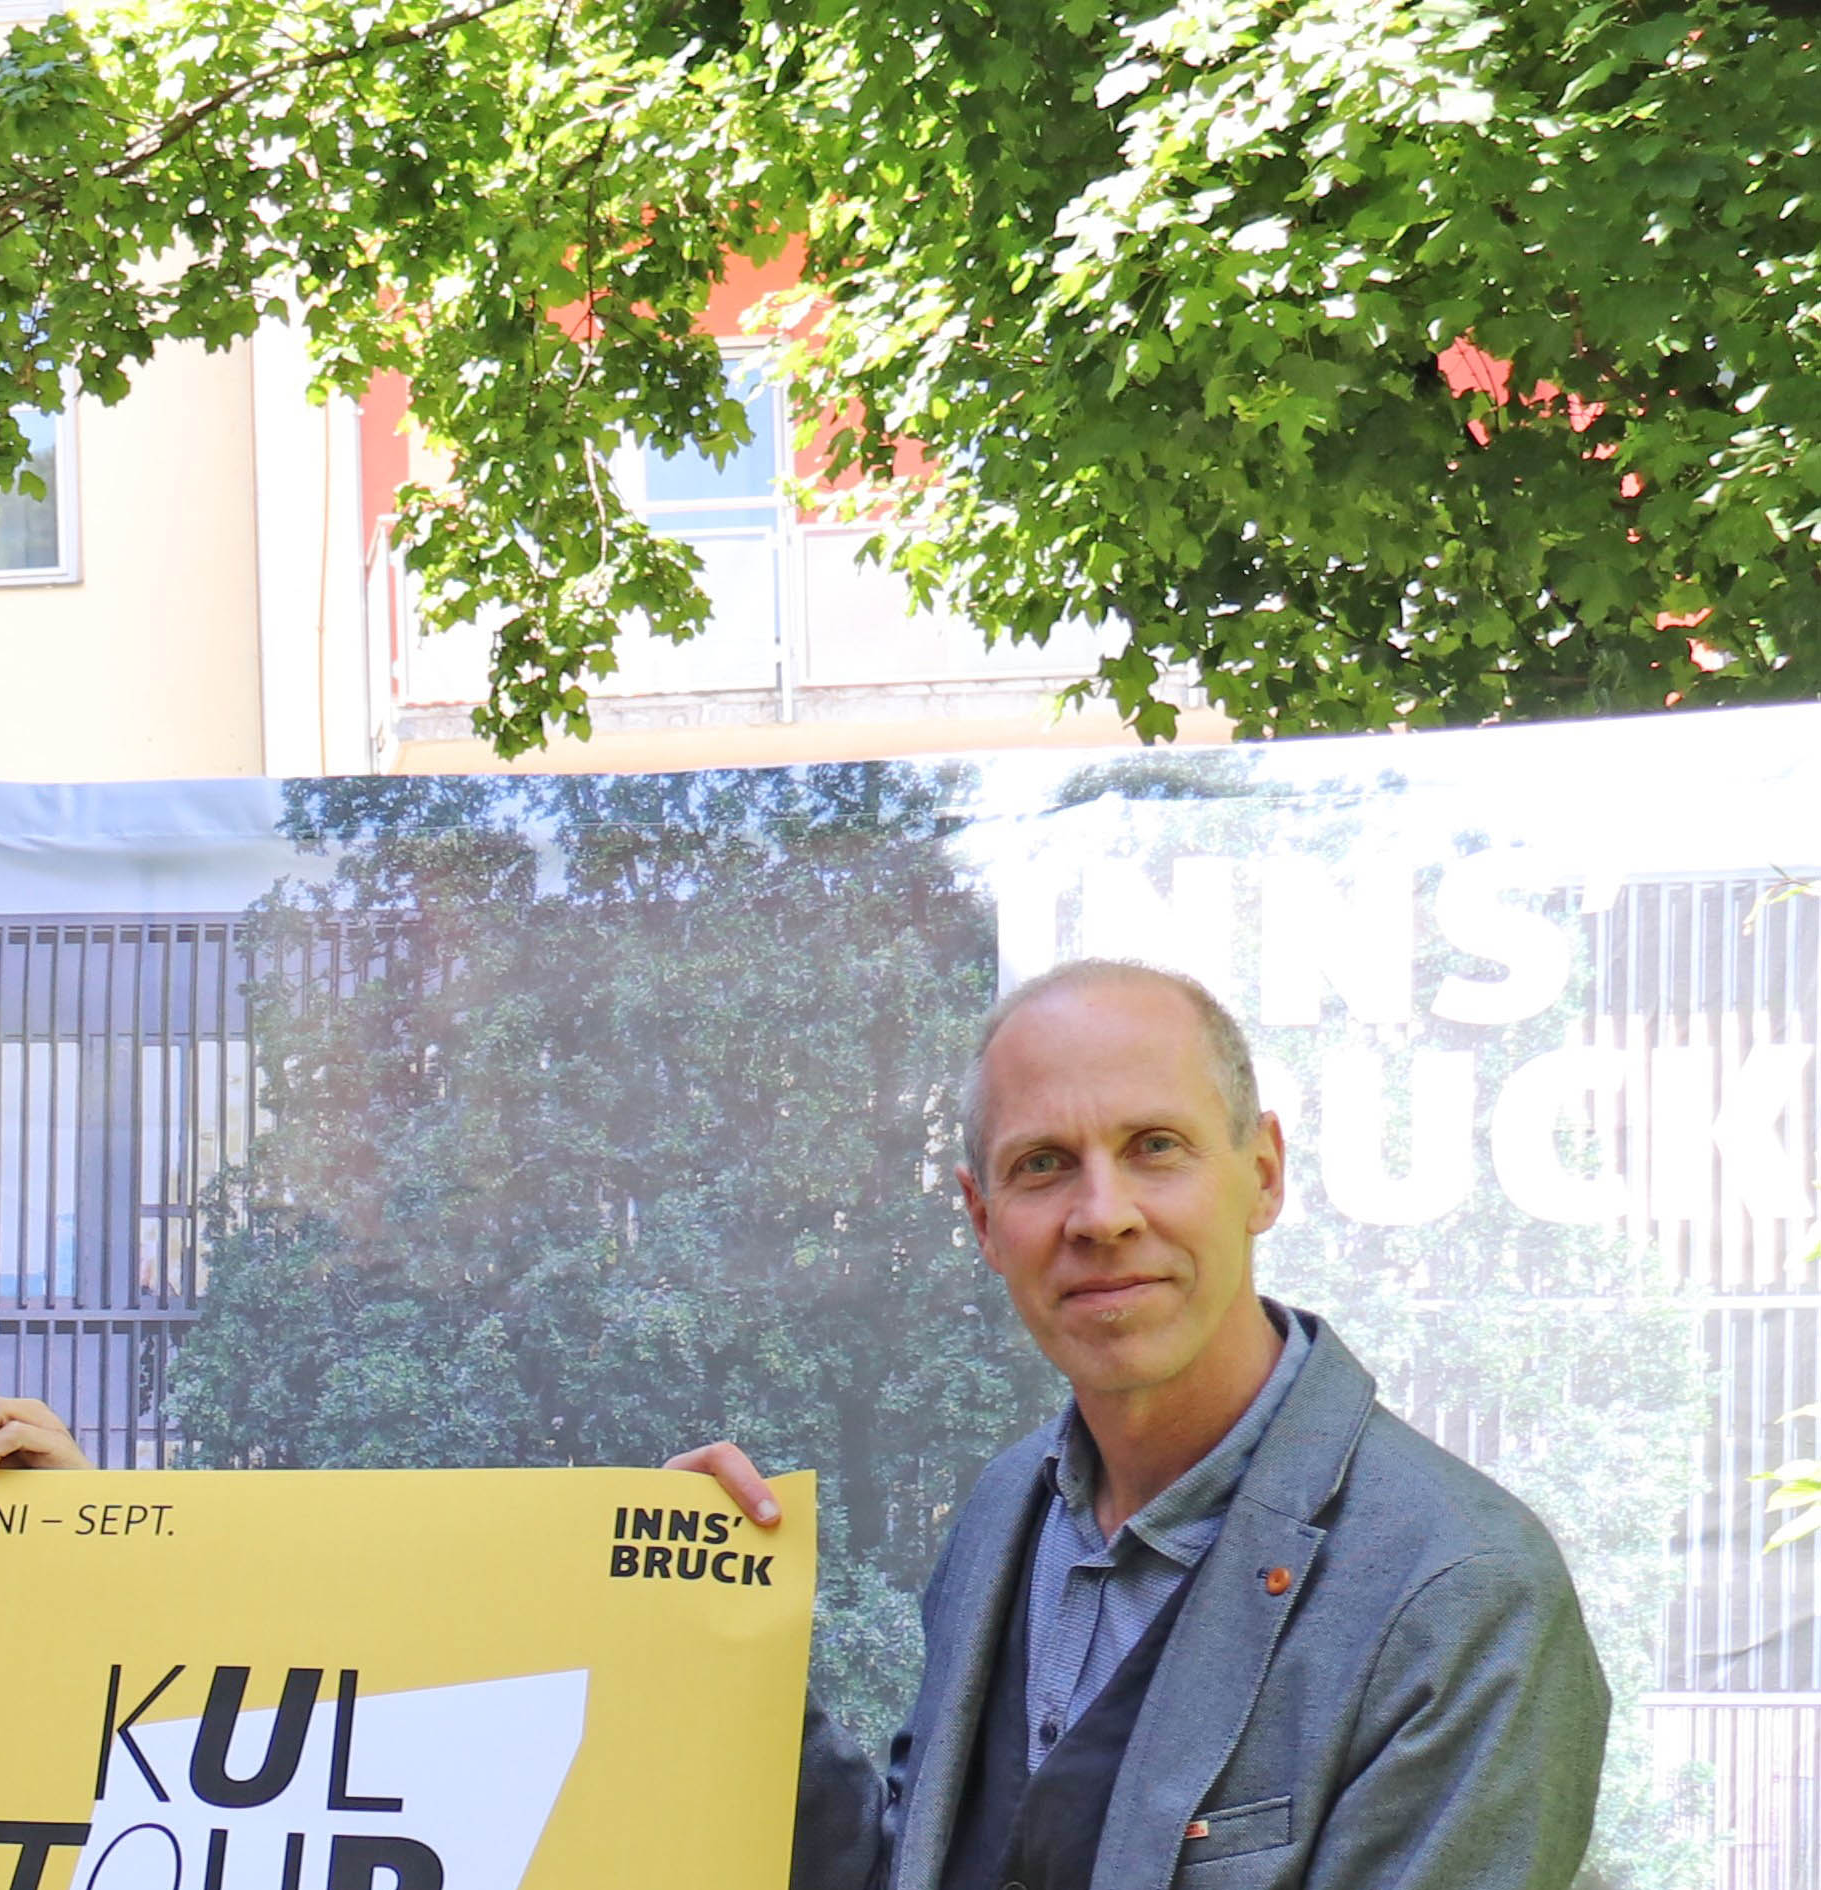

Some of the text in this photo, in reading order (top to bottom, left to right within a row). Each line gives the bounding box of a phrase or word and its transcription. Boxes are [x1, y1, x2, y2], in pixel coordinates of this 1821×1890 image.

[1255, 1044, 1814, 1226] UCK
[75, 1504, 174, 1536] SEPT.
[610, 1545, 774, 1586] BRUCK
[93, 1664, 403, 1812] KUL
